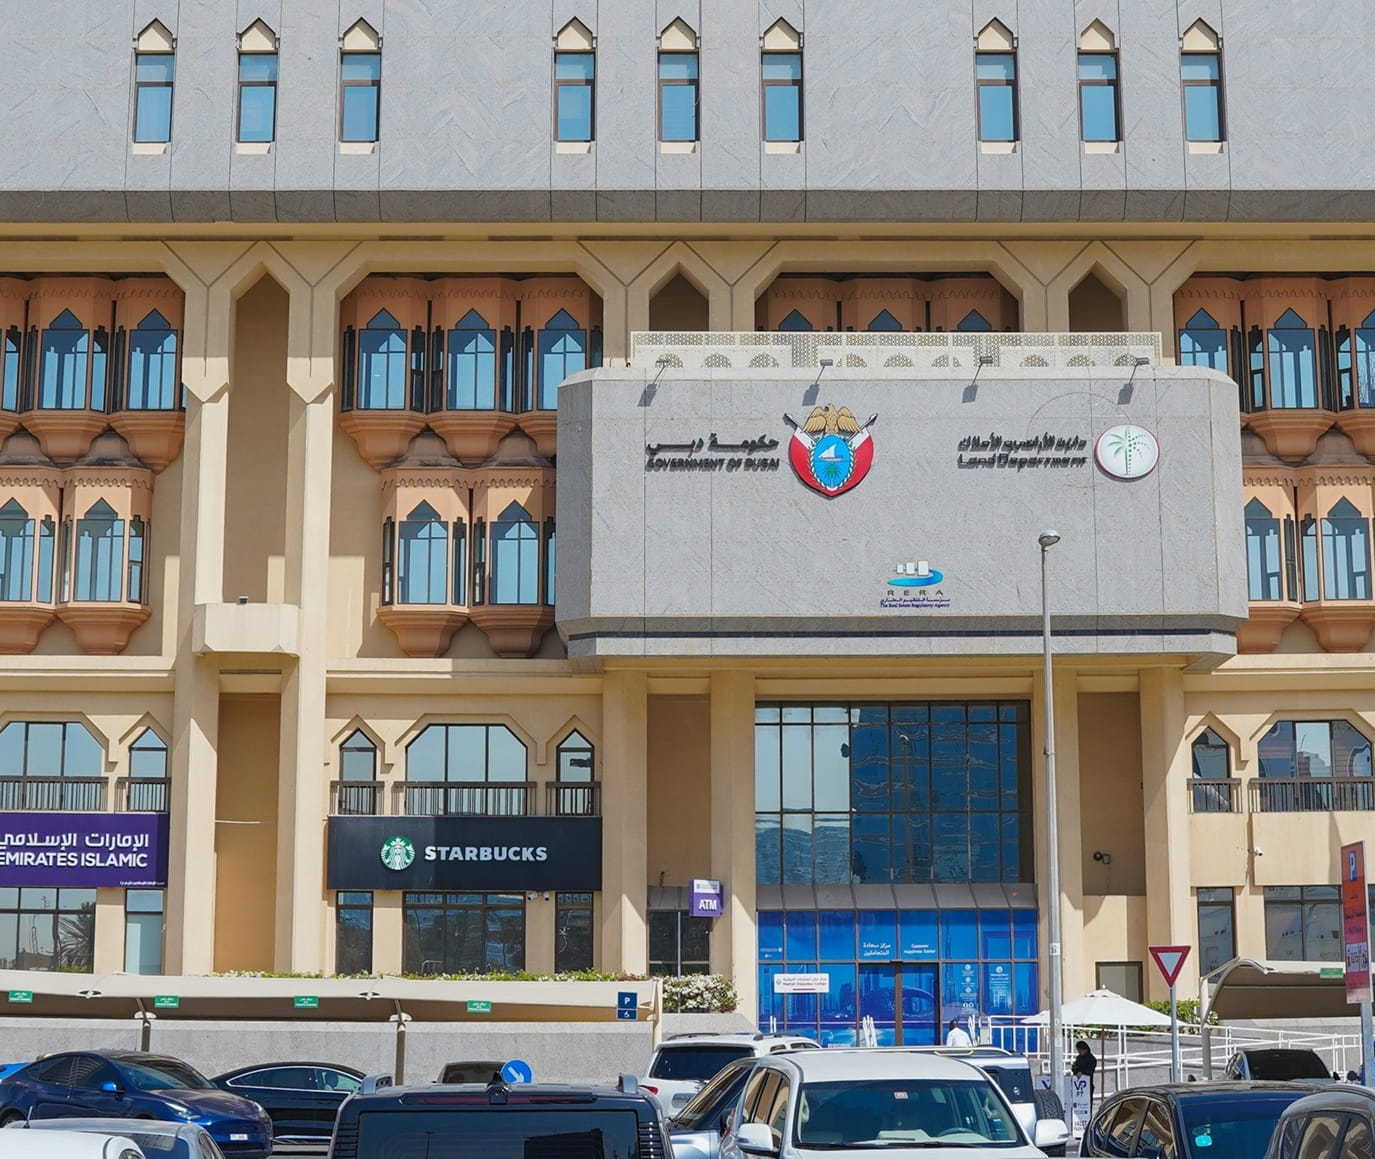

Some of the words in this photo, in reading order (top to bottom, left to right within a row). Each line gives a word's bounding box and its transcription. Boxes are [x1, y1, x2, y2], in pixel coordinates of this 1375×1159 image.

[645, 458, 725, 472] GOVERNMENT
[726, 458, 743, 472] OF
[744, 458, 780, 472] DUBAI
[957, 453, 997, 469] Land
[996, 453, 1088, 473] Department
[85, 833, 149, 851] الإمارات
[81, 852, 149, 868] ISLAMIC
[424, 846, 548, 862] STARBUCKS
[698, 899, 718, 911] ATM
[624, 997, 631, 1005] P
